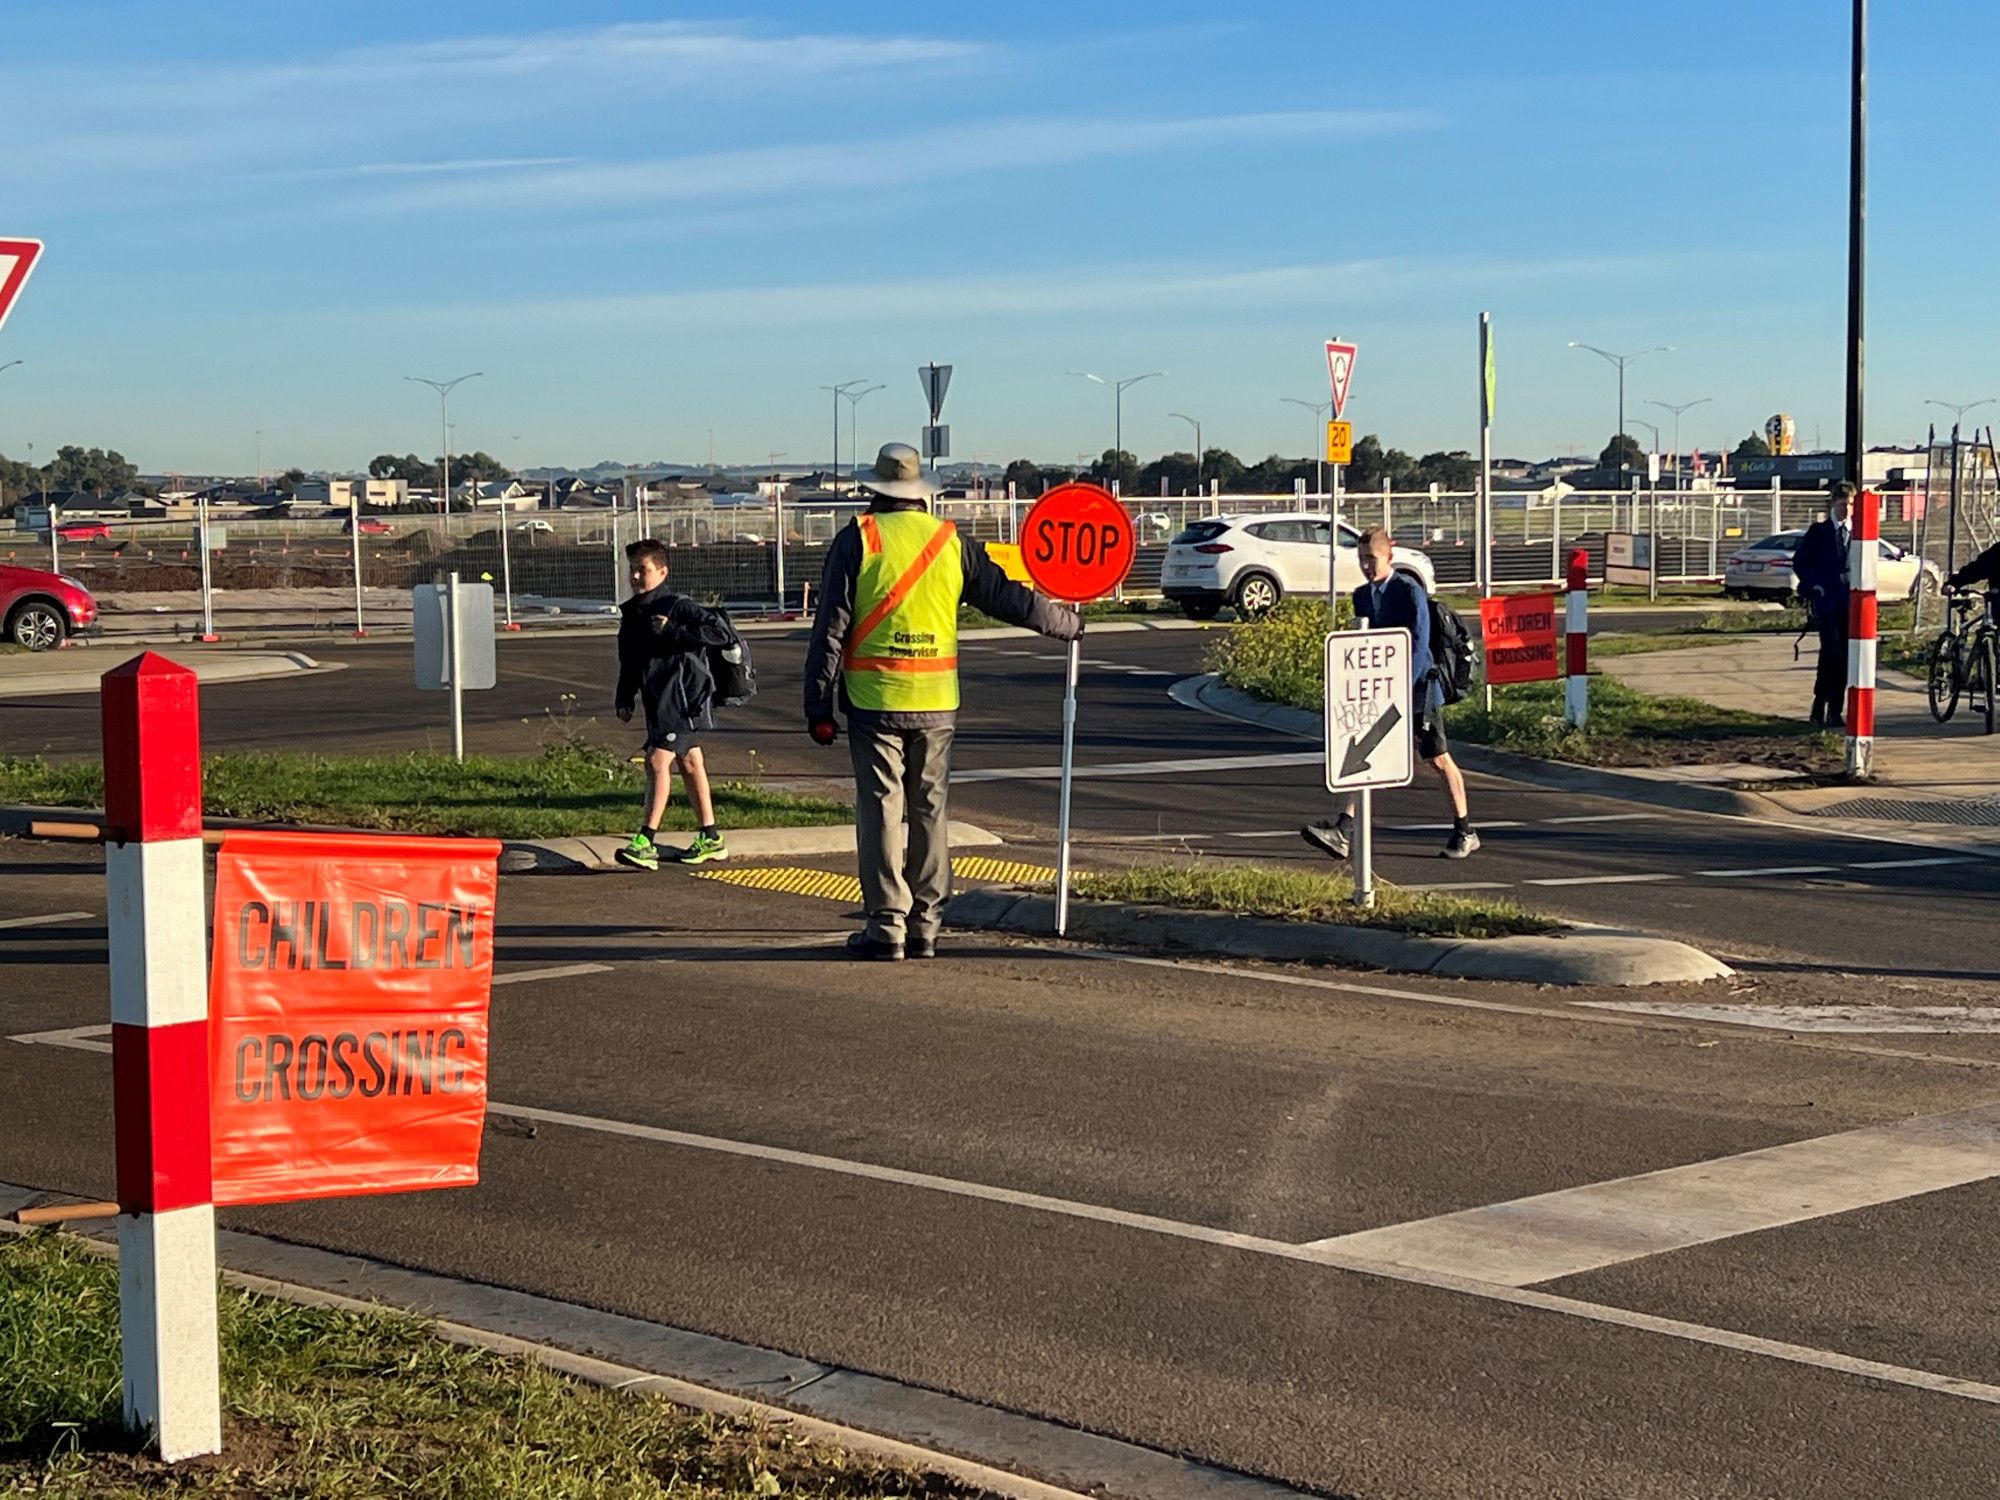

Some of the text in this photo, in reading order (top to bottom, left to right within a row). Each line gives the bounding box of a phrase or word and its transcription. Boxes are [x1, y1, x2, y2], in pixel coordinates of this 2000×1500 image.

[1332, 426, 1347, 447] 20
[1035, 519, 1119, 566] STOP
[1487, 612, 1551, 634] CHILDREN
[894, 632, 935, 644] Crossing
[1344, 645, 1396, 670] KEEP
[1492, 643, 1553, 666] CROSSING
[1346, 677, 1394, 702] LEFT
[238, 900, 476, 971] CHILDREN
[235, 1028, 466, 1103] CROSSING
